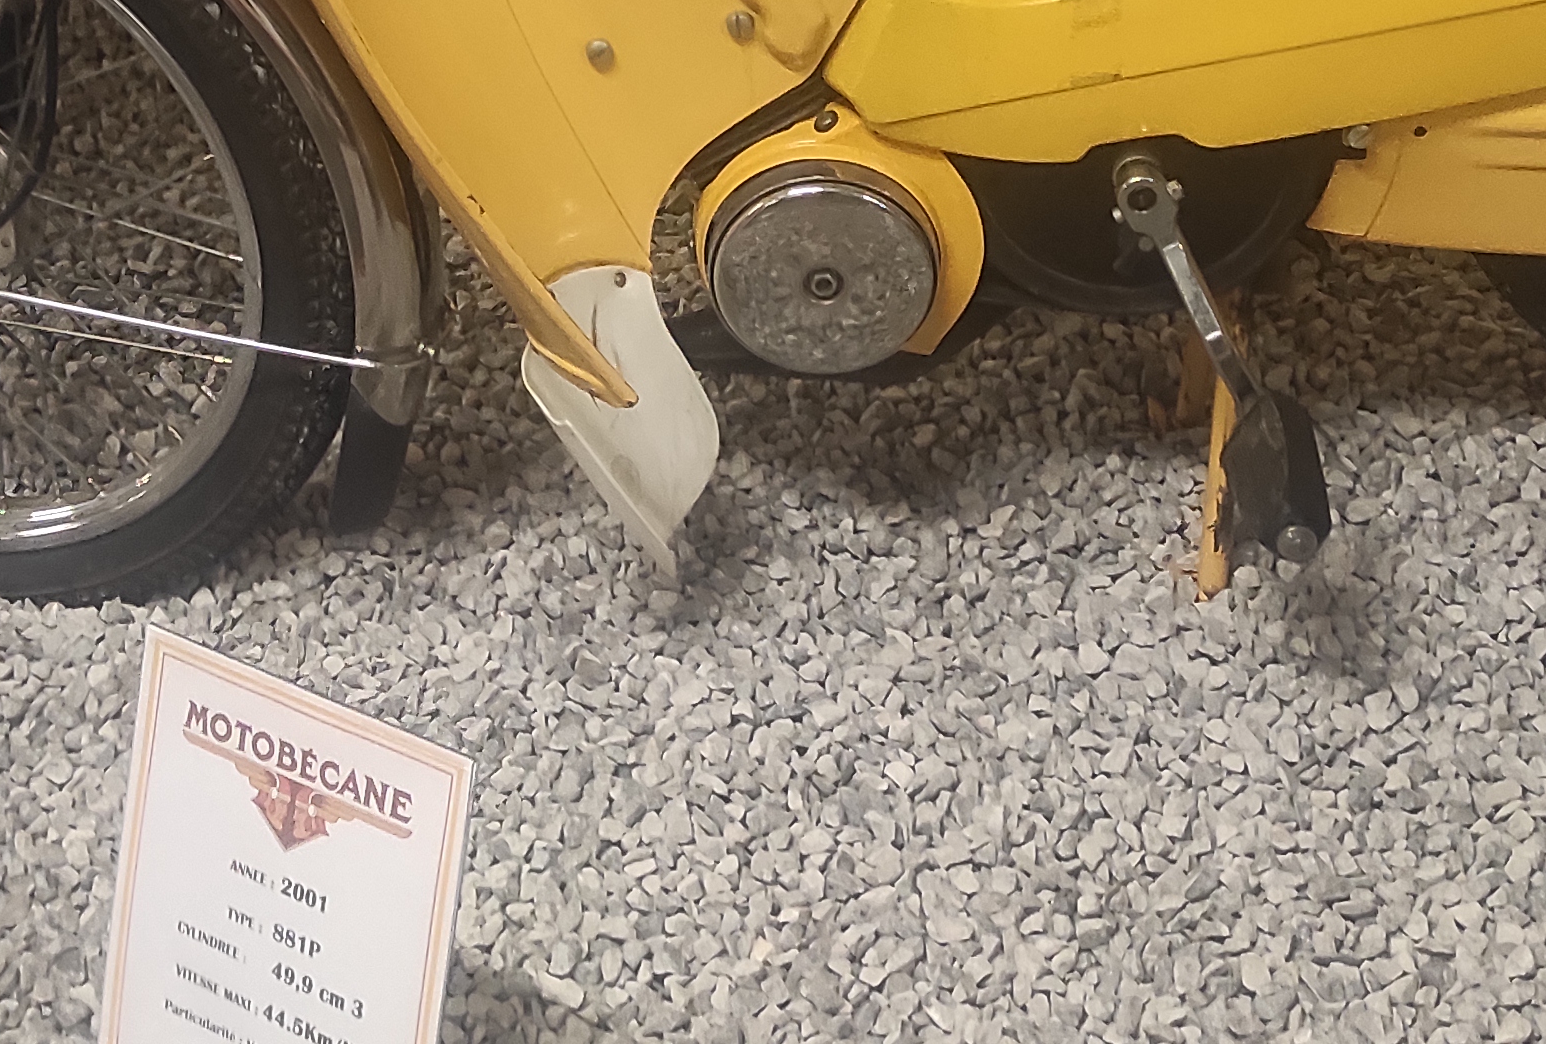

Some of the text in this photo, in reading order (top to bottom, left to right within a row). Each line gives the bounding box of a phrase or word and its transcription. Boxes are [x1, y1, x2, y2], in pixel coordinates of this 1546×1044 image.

[184, 699, 414, 824] MOTOBÉCANE
[280, 876, 327, 914] 2001
[227, 906, 254, 930] TYPE
[272, 922, 321, 958] 881P
[175, 963, 220, 995] VITESSE
[223, 987, 253, 1013] MAXI
[271, 961, 314, 994] 49,9
[318, 987, 345, 1012] cm
[352, 998, 364, 1019] 3
